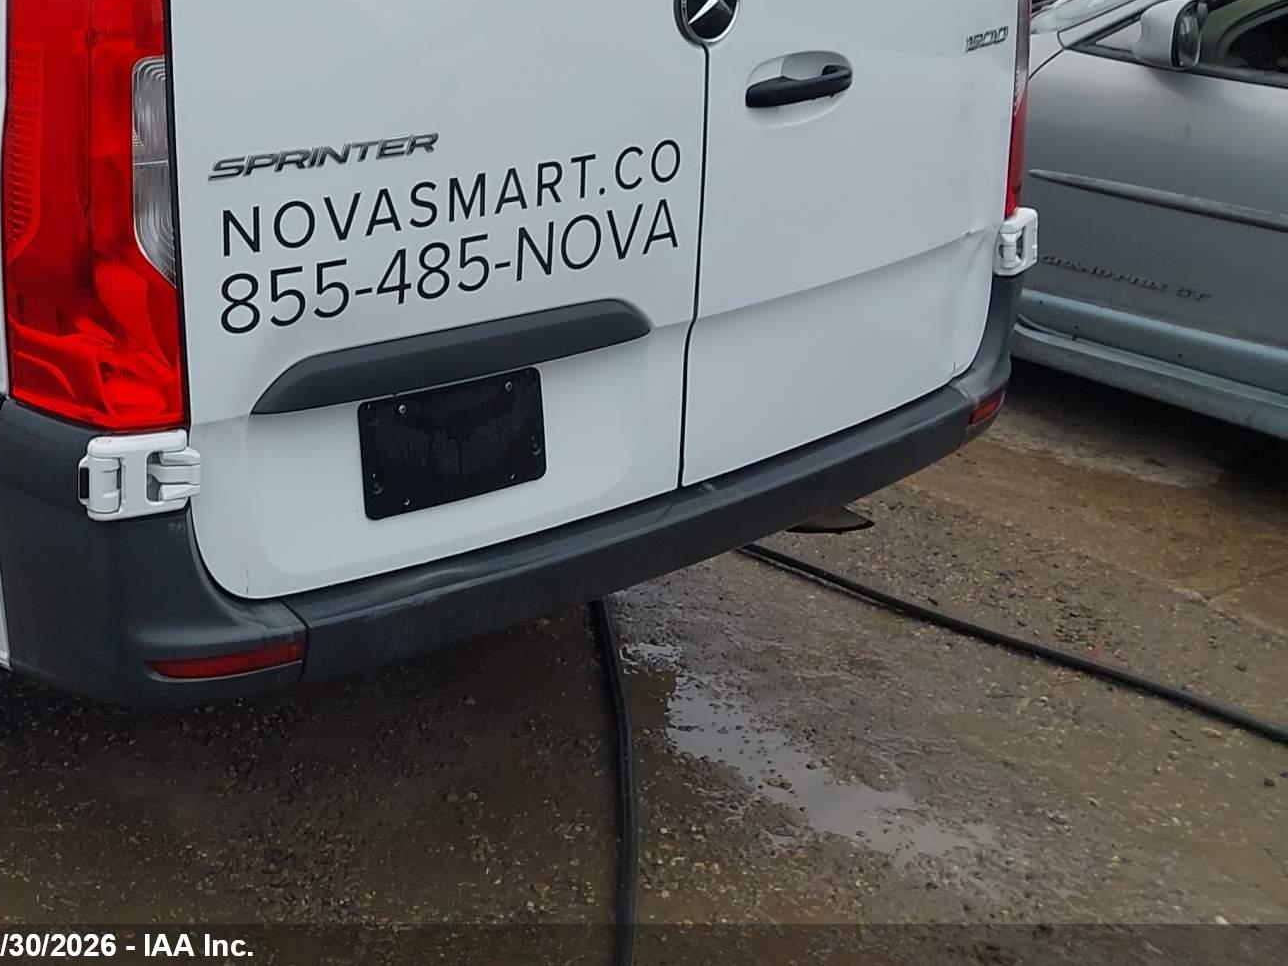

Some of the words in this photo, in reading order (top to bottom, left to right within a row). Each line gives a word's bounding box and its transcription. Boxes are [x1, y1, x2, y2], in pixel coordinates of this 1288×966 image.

[208, 133, 439, 181] SPRINTER
[222, 139, 681, 258] NOVASMART.CO
[220, 198, 680, 335] 855-485-NOVA
